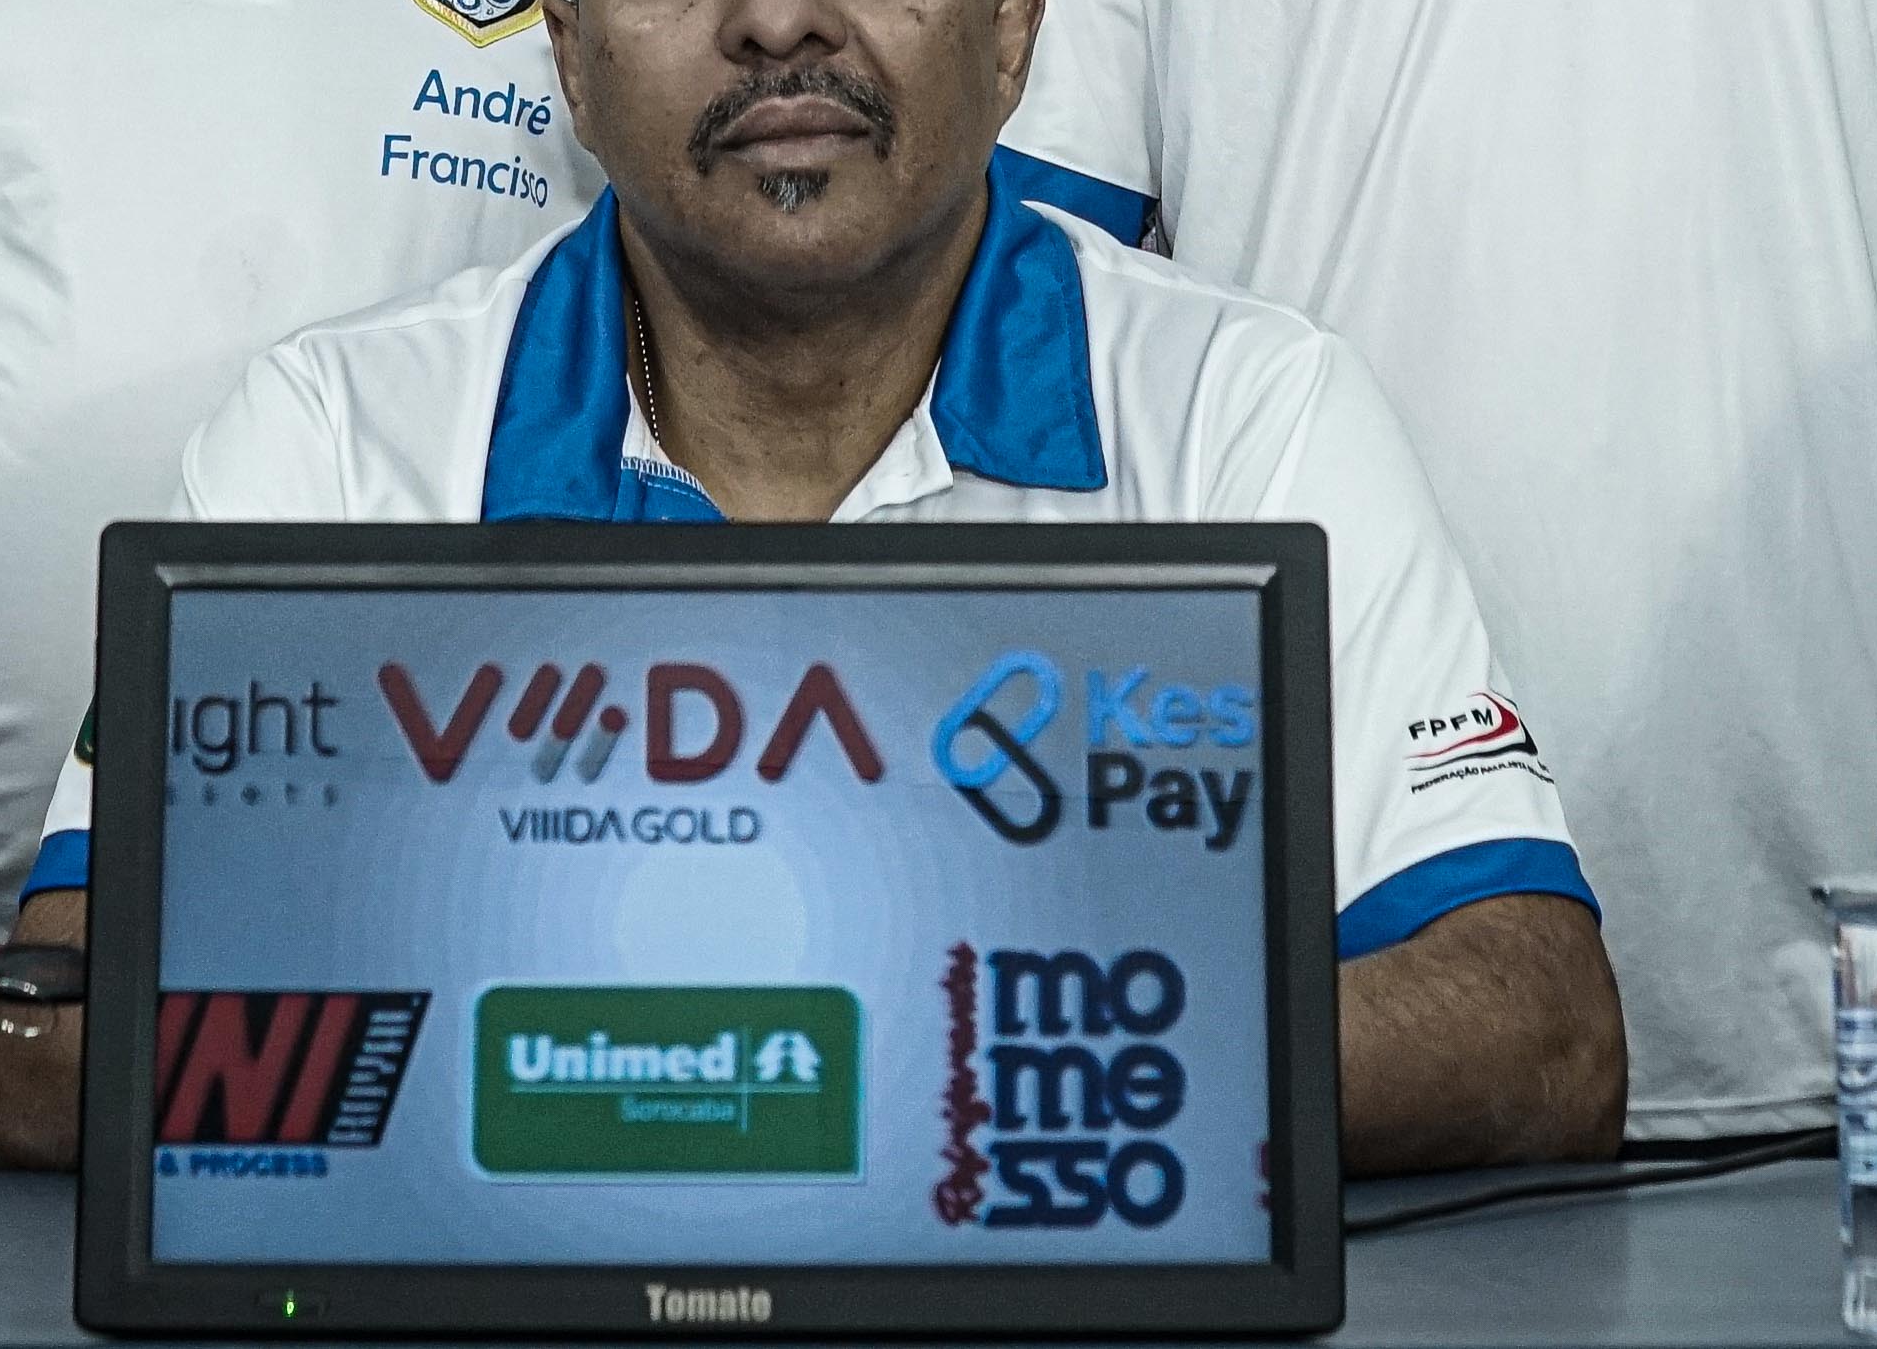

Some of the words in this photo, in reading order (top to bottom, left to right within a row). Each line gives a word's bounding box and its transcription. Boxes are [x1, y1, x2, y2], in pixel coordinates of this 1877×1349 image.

[413, 68, 552, 136] André
[380, 134, 549, 209] Francisco
[173, 679, 338, 776] ight
[1087, 664, 1256, 749] Kes
[1408, 707, 1494, 741] FPFM
[1086, 753, 1254, 851] Pay
[988, 949, 1184, 1036] mo
[510, 1031, 737, 1082] Unimed
[988, 1045, 1184, 1130] me
[647, 1284, 773, 1324] Tomato
